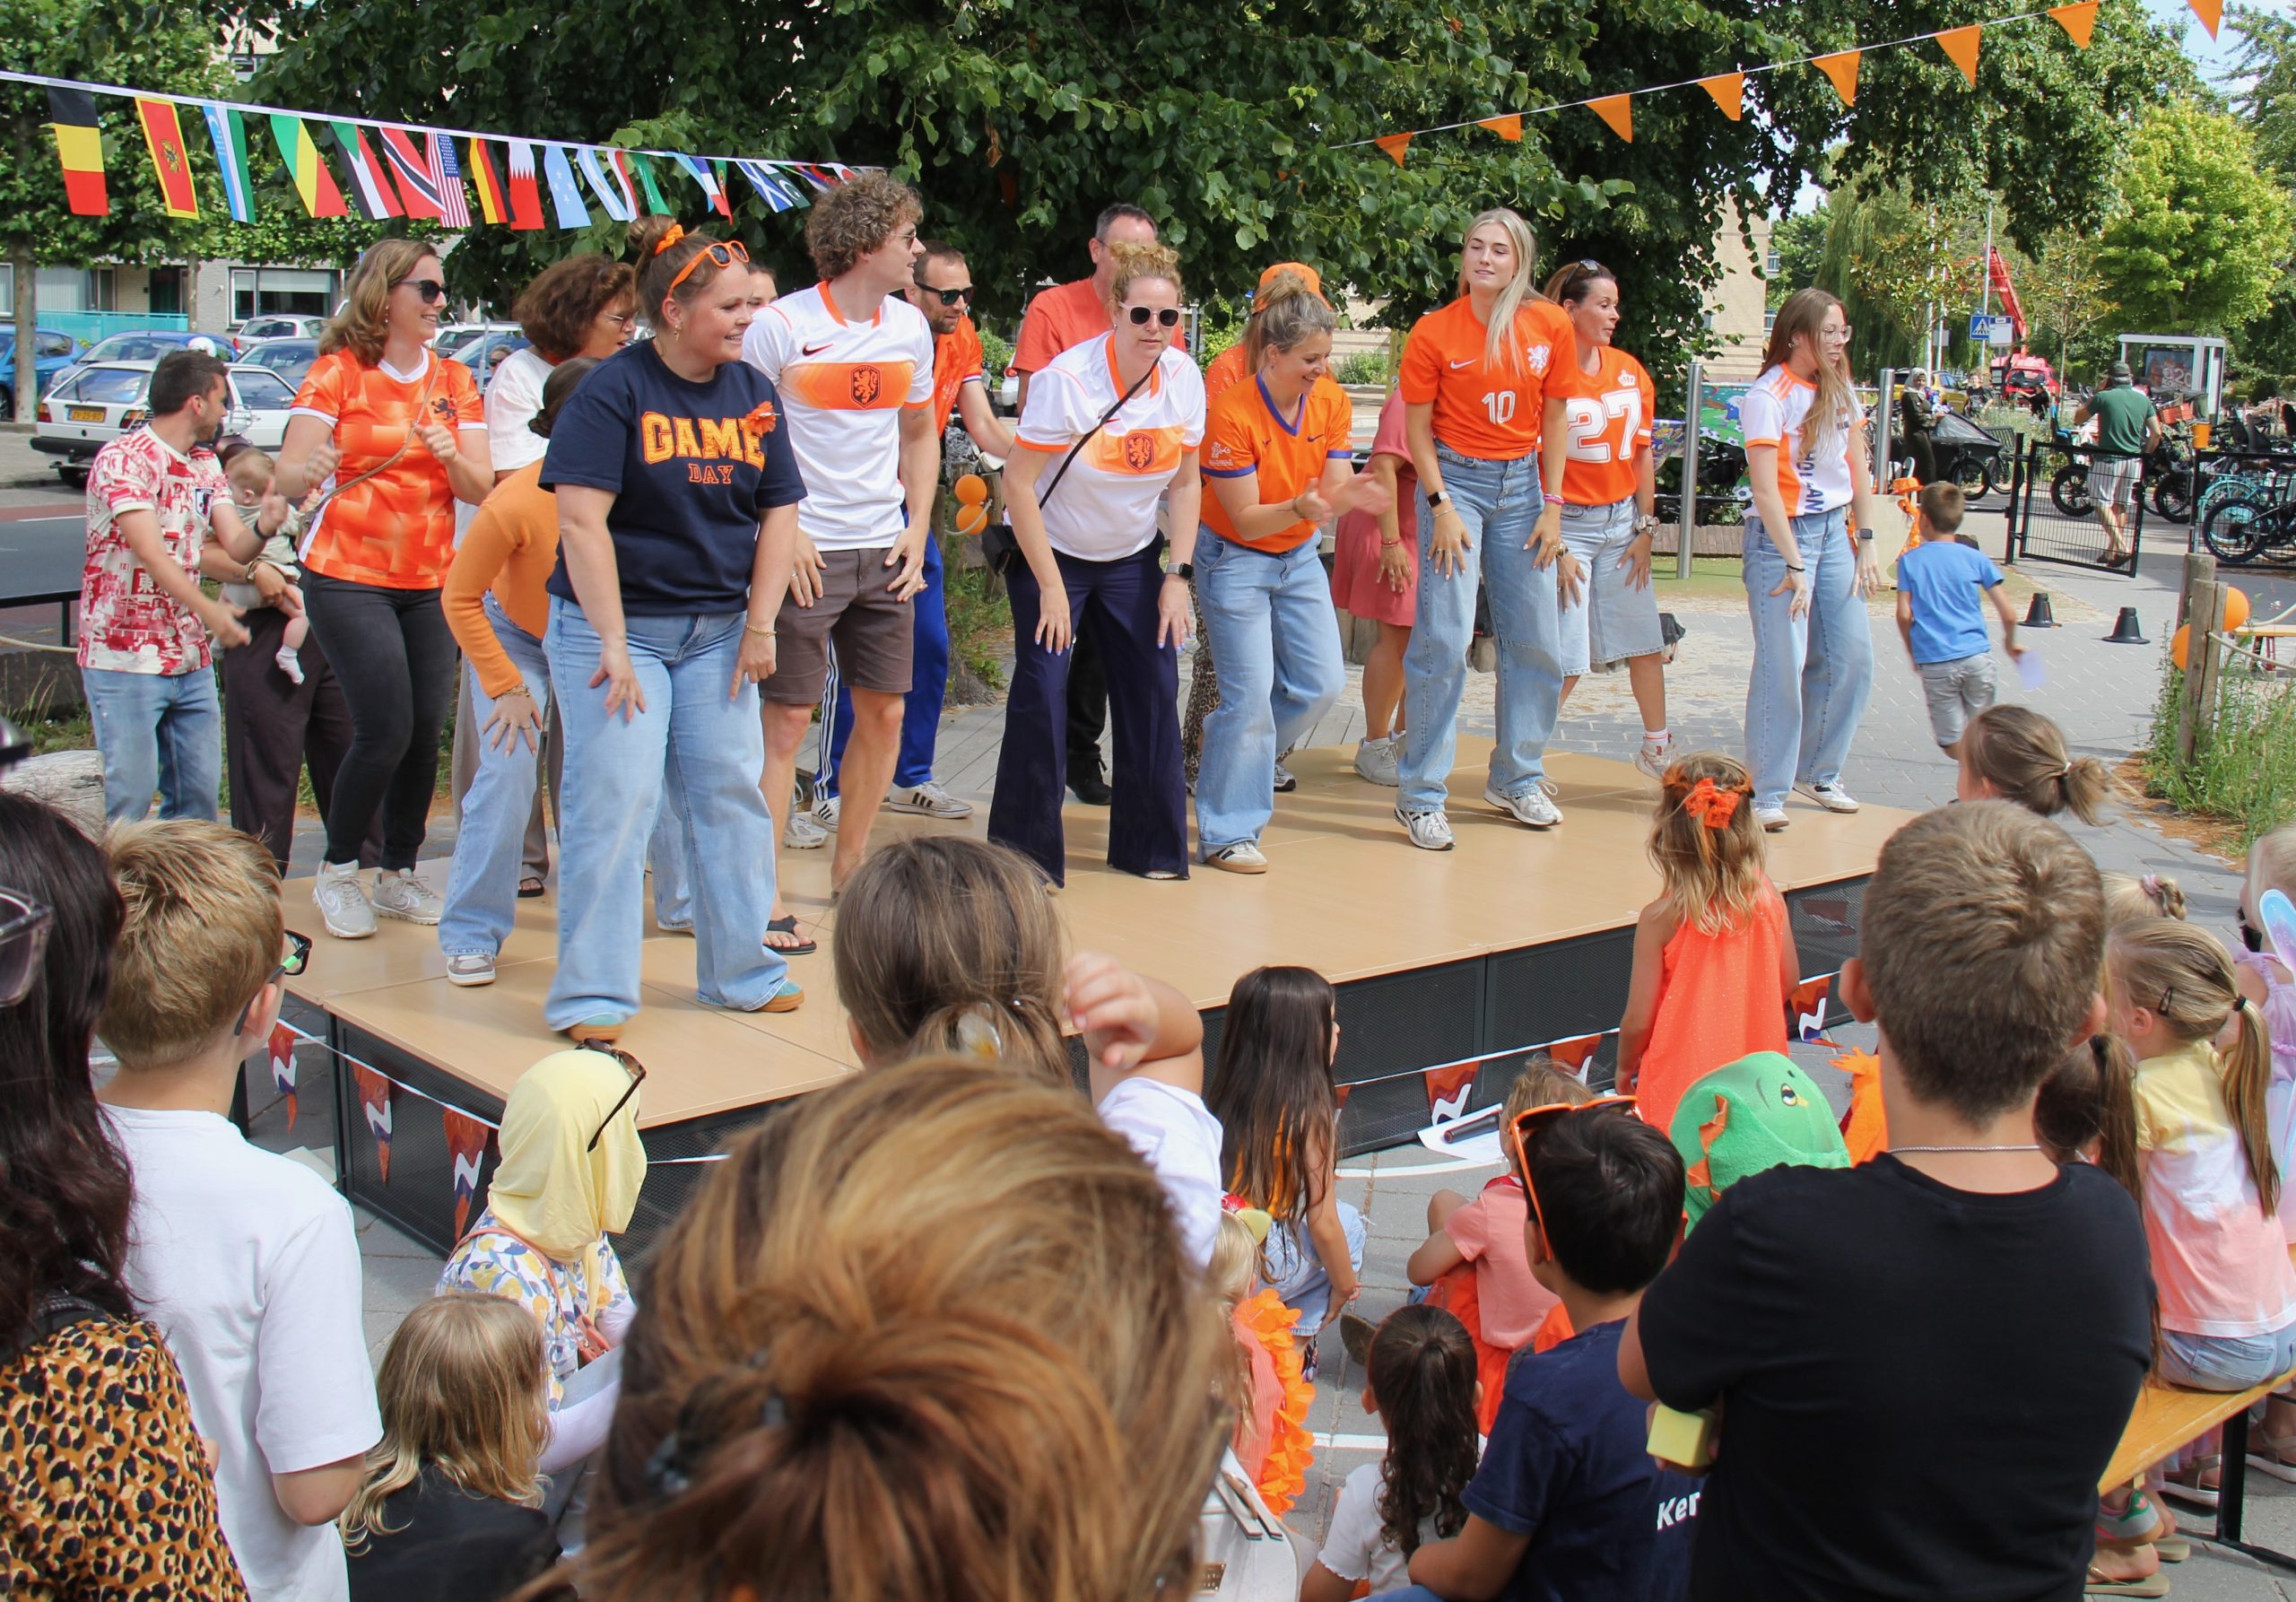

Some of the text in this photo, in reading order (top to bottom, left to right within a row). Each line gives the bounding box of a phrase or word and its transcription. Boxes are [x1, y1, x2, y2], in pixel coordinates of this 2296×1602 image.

[1481, 390, 1516, 424] 10
[1566, 387, 1641, 464] 27
[640, 411, 765, 473] GAME
[688, 463, 734, 484] DAY
